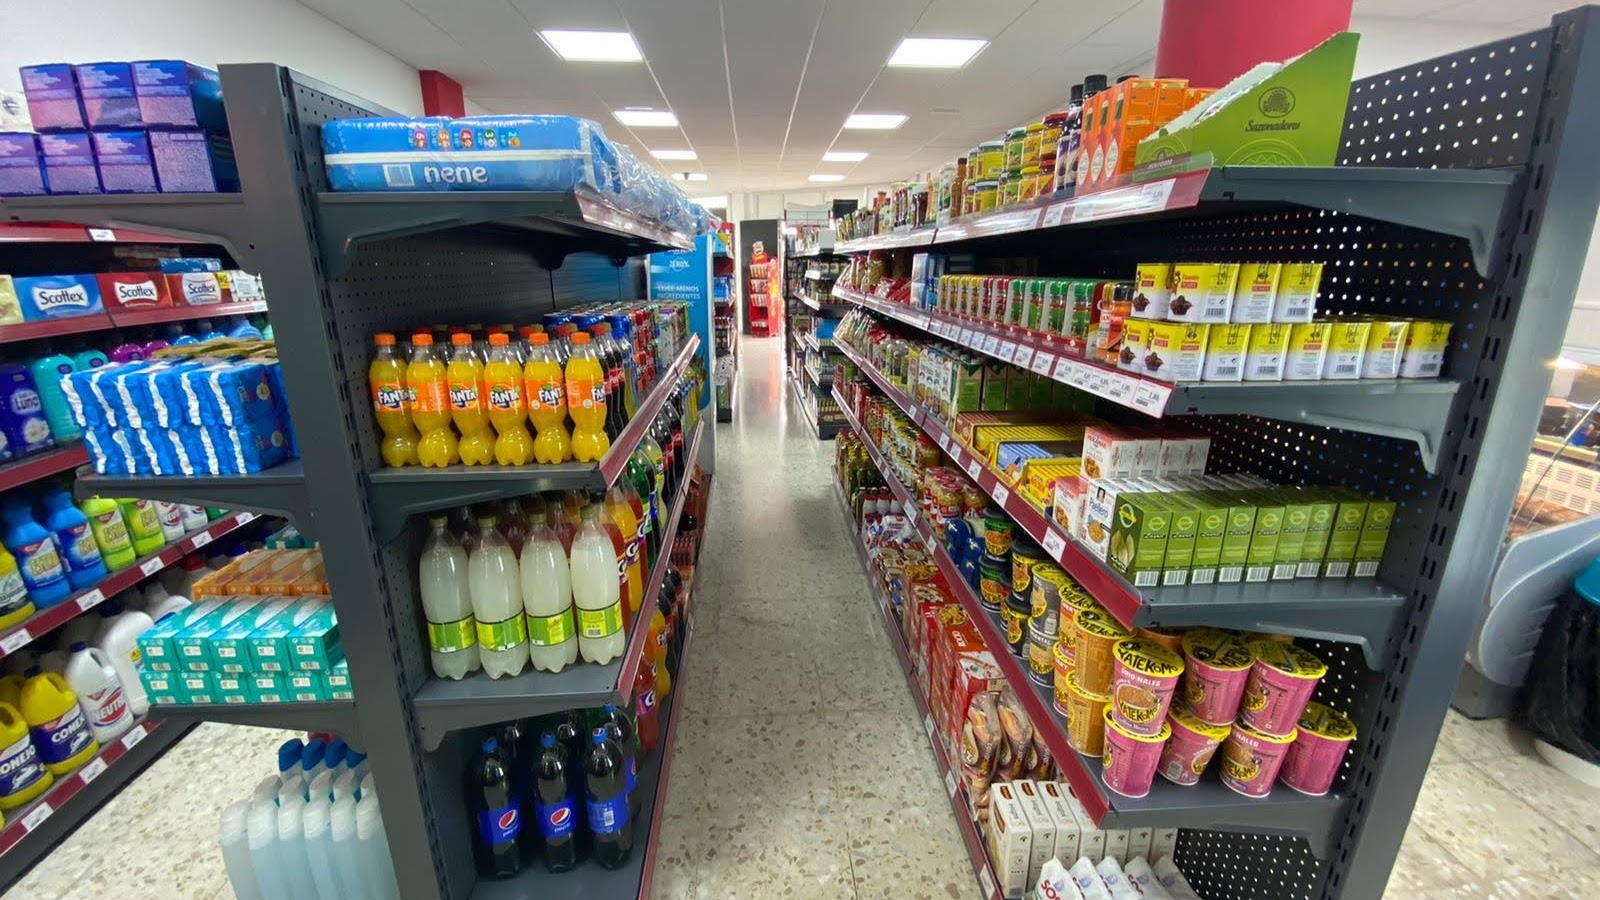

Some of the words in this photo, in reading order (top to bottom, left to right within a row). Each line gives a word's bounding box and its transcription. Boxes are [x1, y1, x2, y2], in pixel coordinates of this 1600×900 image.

[423, 164, 488, 183] nene
[39, 290, 85, 305] Scottex
[119, 282, 155, 299] Scottex
[188, 282, 217, 296] Scottex
[538, 388, 563, 402] FANT
[1117, 647, 1180, 675] YATEKOMO
[1119, 701, 1159, 722] YATEKOMO
[0, 745, 36, 774] ONEJO
